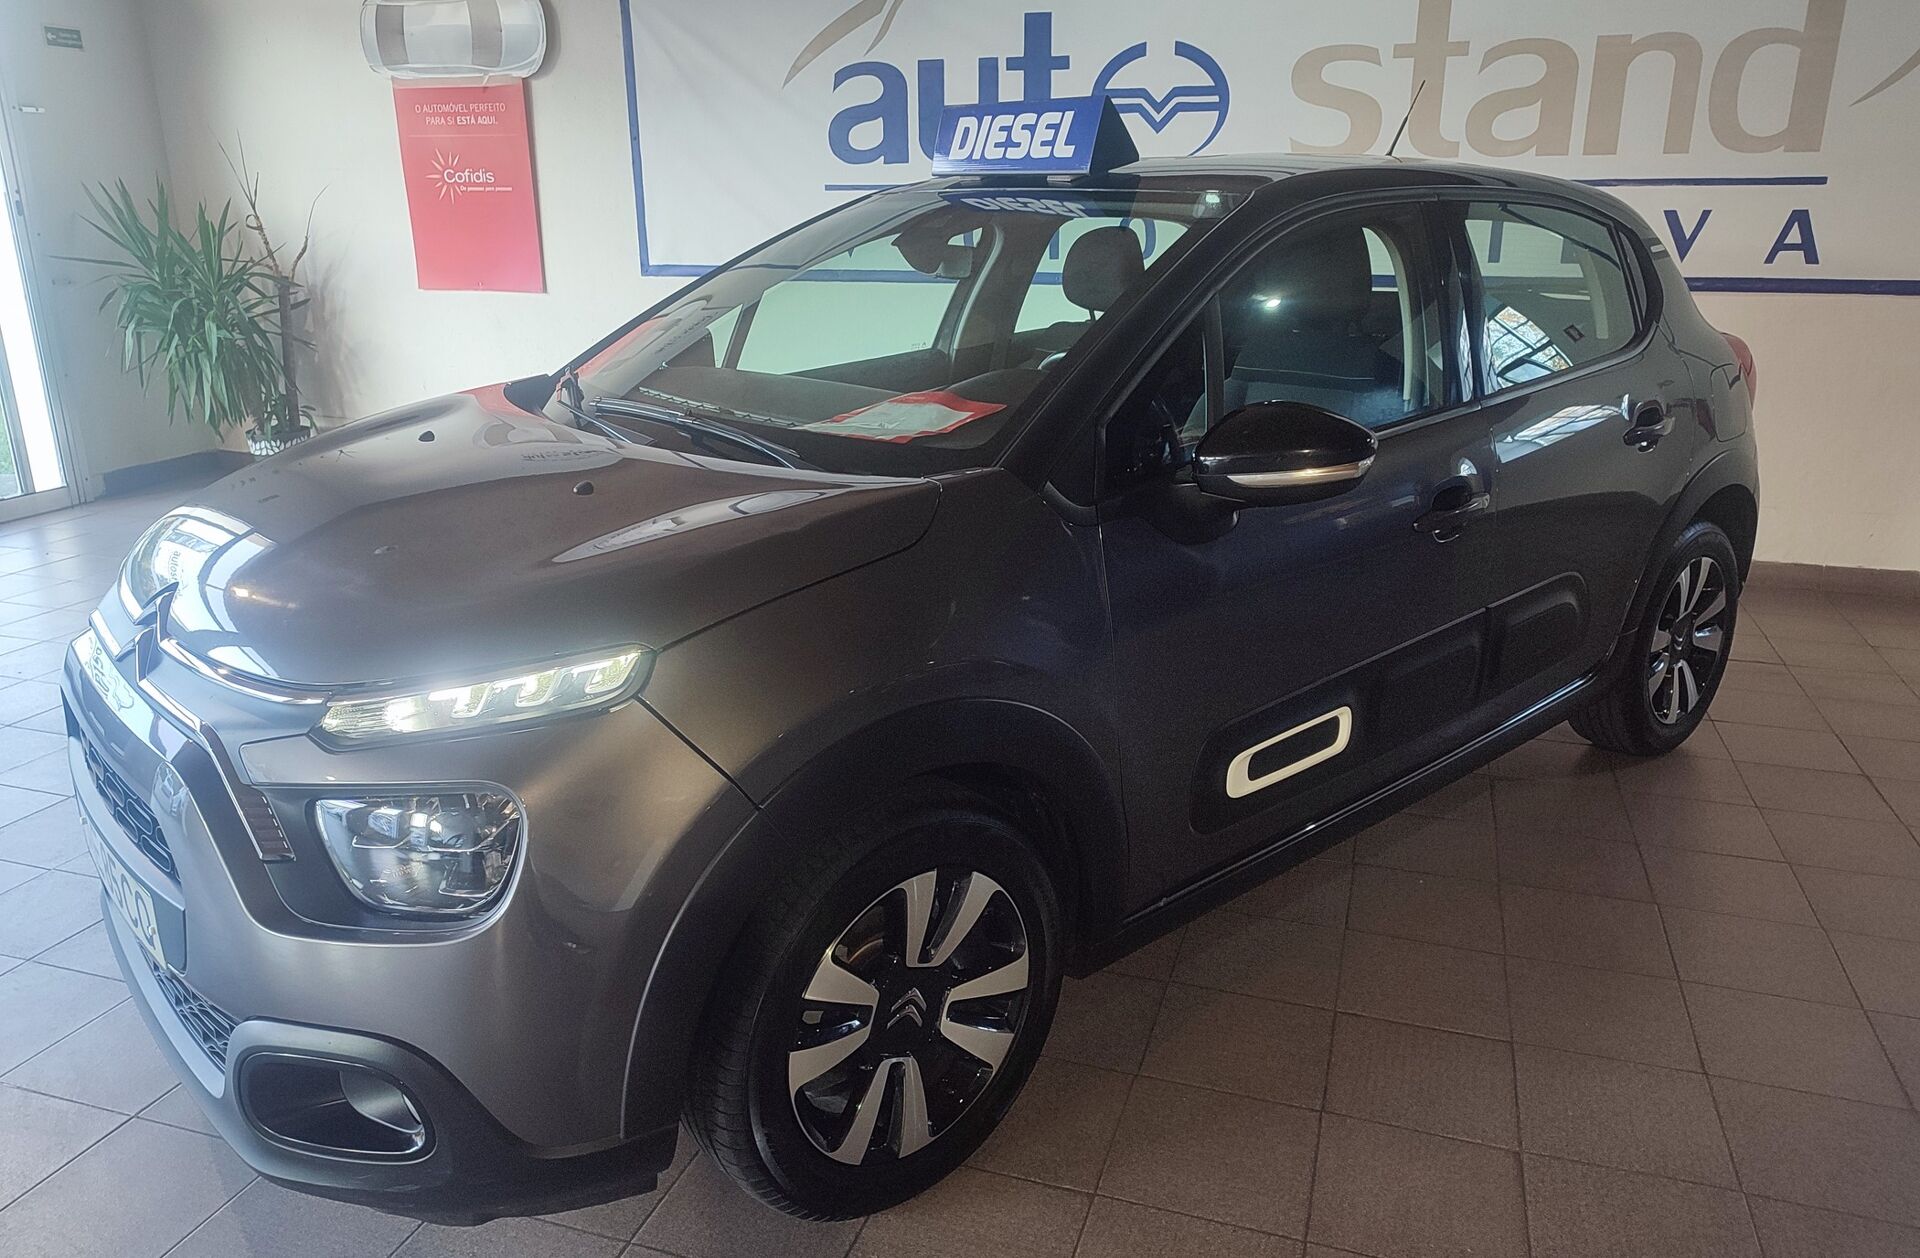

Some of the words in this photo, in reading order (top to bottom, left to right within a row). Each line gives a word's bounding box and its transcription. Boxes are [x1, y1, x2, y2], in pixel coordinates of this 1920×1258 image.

[1289, 0, 1846, 158] stand
[414, 104, 421, 114] O
[422, 102, 468, 113] AUTOMÓVEL
[469, 102, 506, 112] PERFEITO
[425, 116, 446, 126] PARA
[447, 116, 455, 125] SI
[456, 113, 476, 125] ESTÁ
[948, 110, 1076, 160] DIESEL
[443, 168, 495, 184] Cofidis
